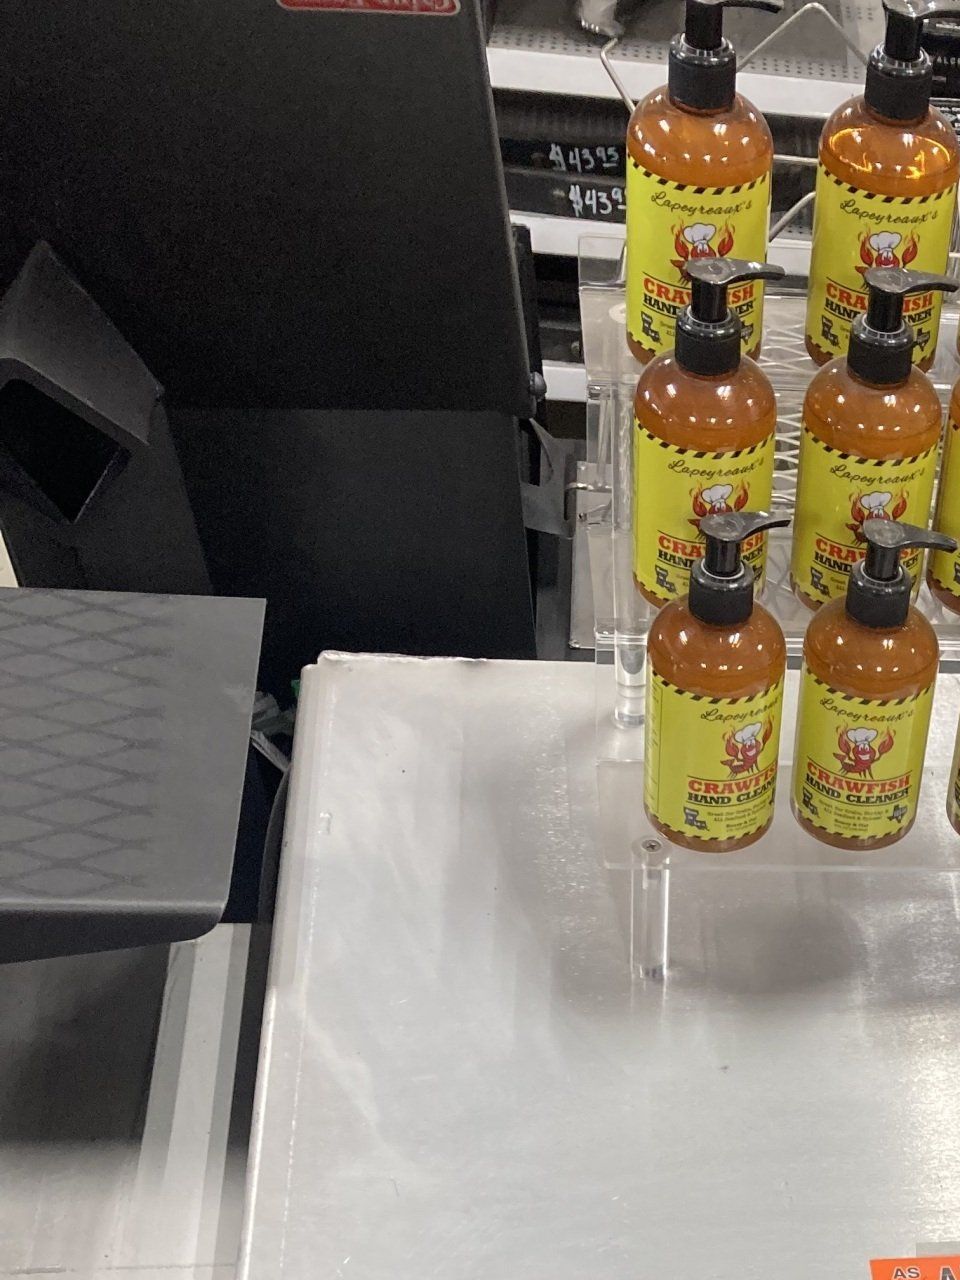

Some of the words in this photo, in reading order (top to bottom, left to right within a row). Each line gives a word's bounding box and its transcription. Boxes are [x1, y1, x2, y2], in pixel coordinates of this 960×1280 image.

[569, 184, 626, 217] $439
[806, 773, 840, 799] HAND
[846, 787, 909, 804] CLEANER
[807, 761, 910, 794] CRAWFISH
[688, 792, 731, 805] HAND
[893, 1267, 920, 1280] AS
